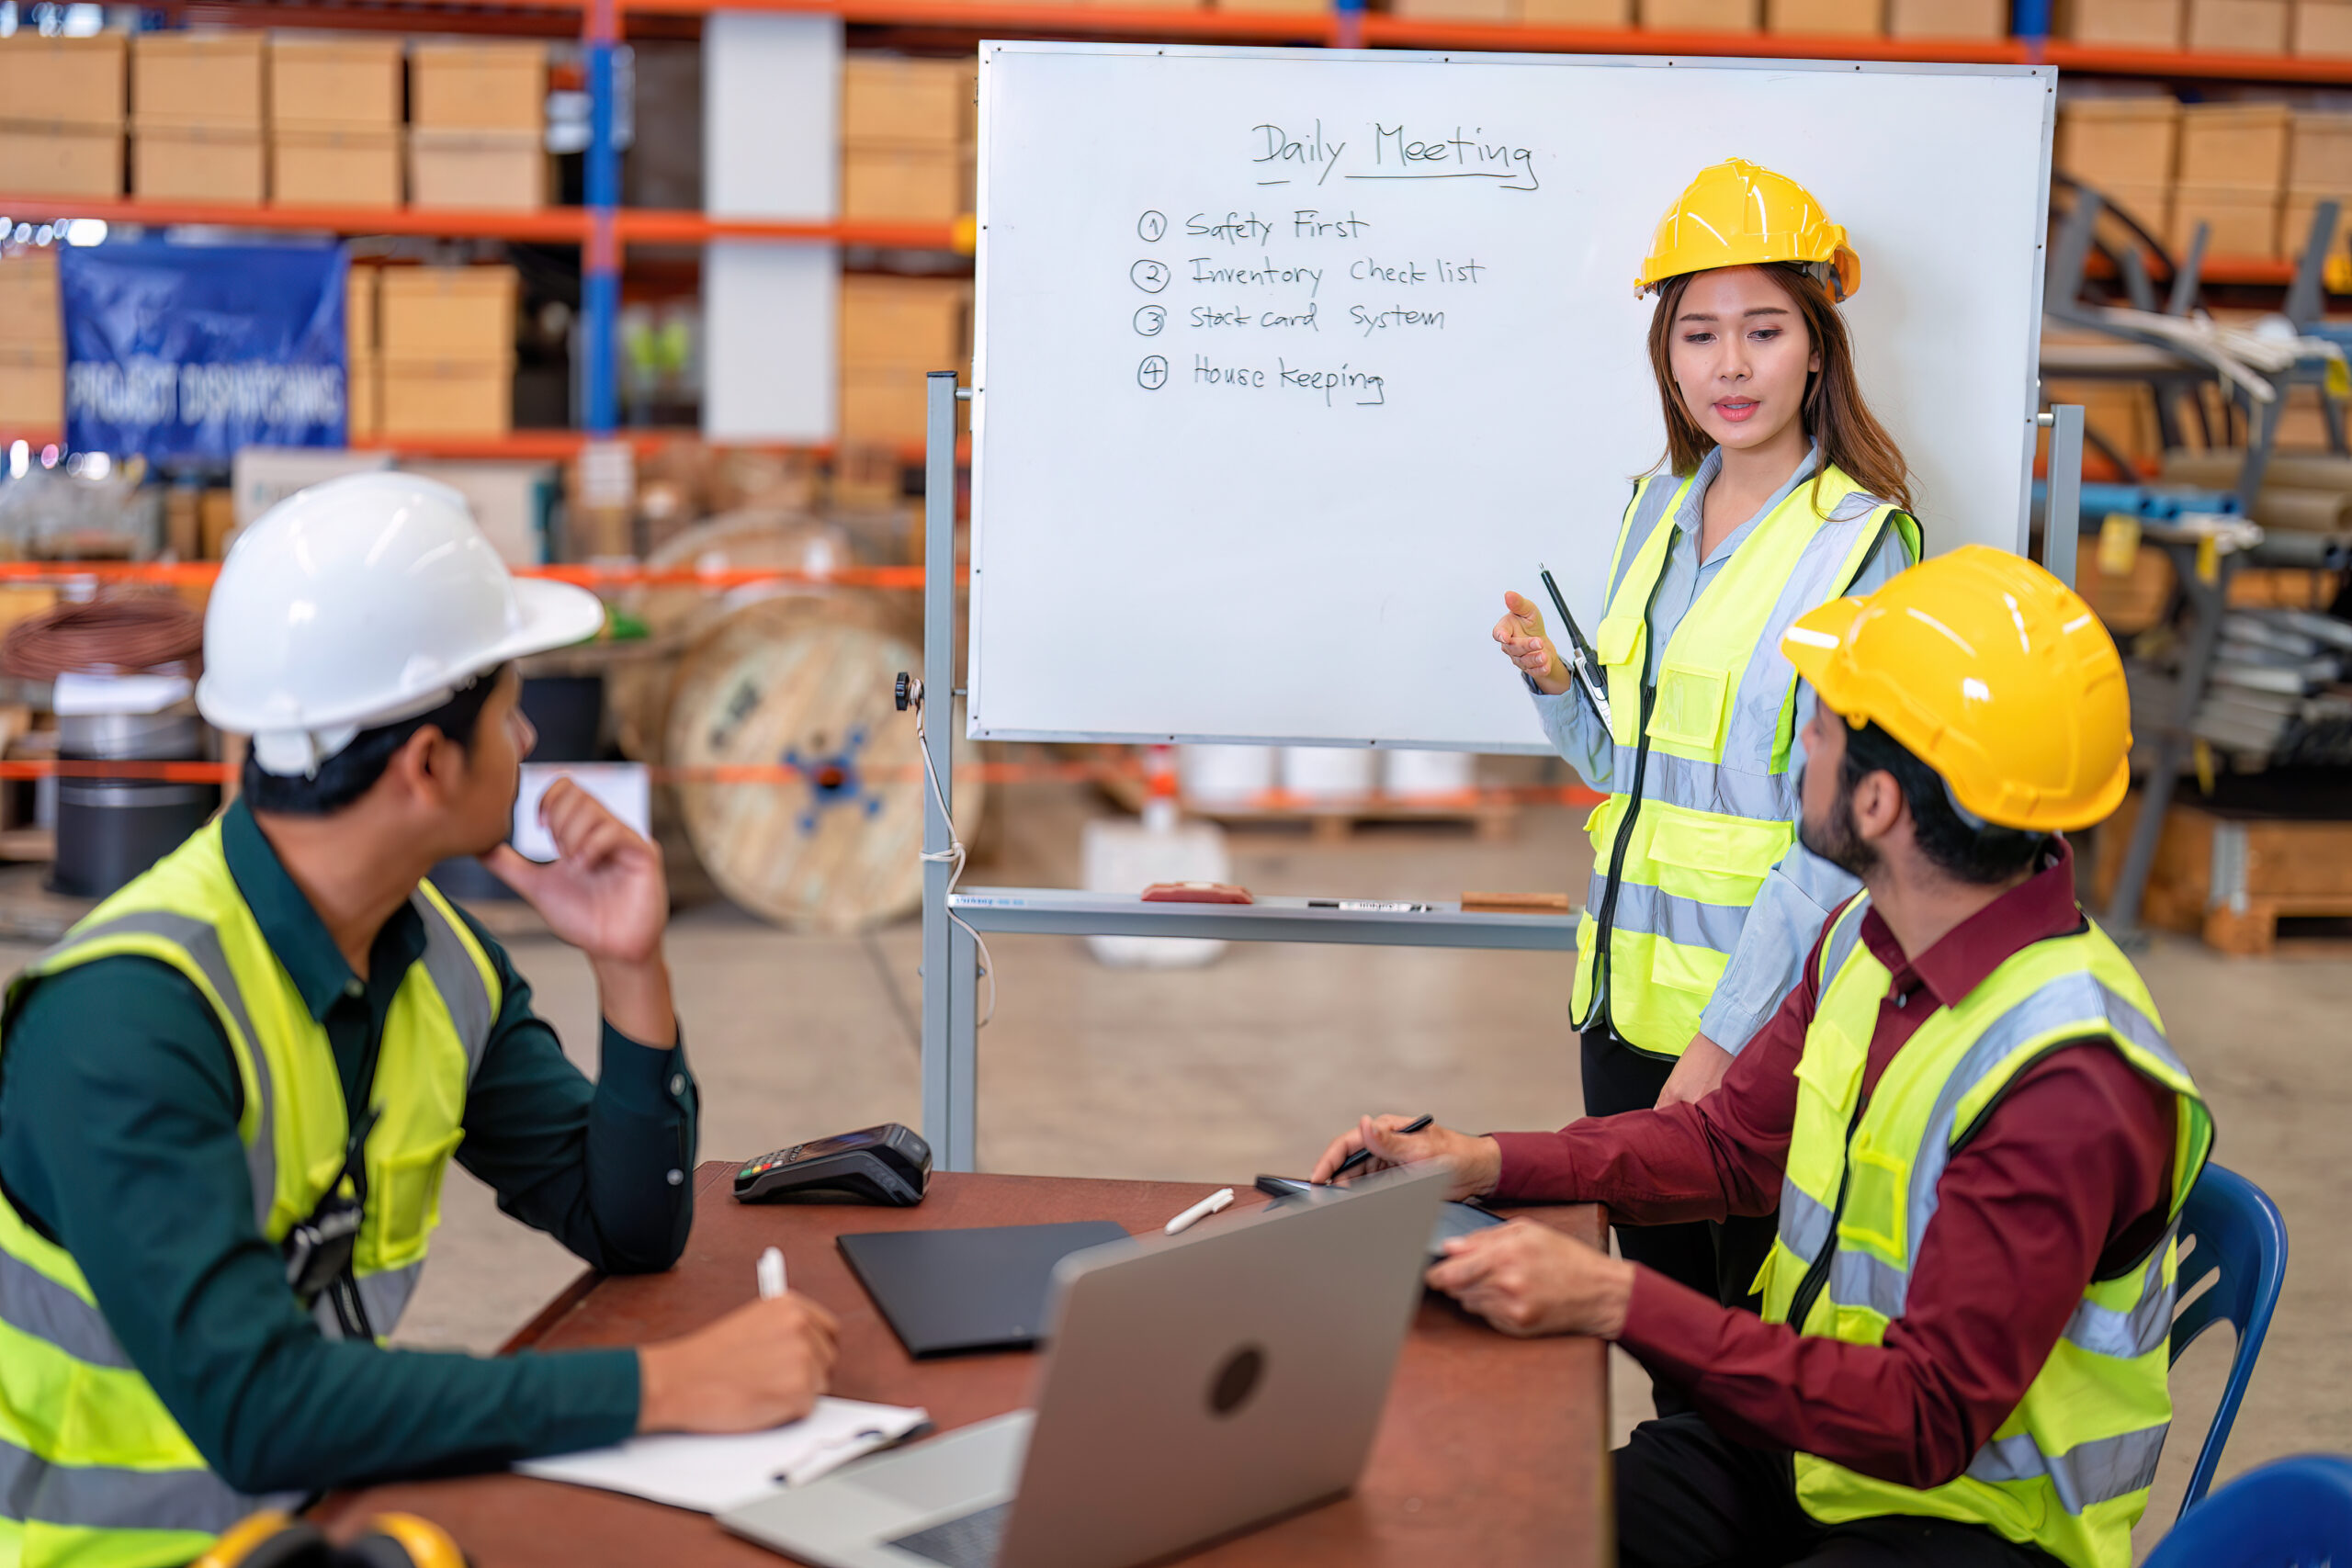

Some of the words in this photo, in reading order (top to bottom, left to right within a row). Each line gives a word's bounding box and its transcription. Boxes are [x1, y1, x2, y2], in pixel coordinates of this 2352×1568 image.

[1251, 118, 1347, 186] Daily
[1375, 123, 1540, 191] Meeting
[1185, 211, 1273, 246] Safety
[1294, 210, 1371, 239] First
[1188, 256, 1323, 299] Inventory
[1350, 304, 1445, 338] System
